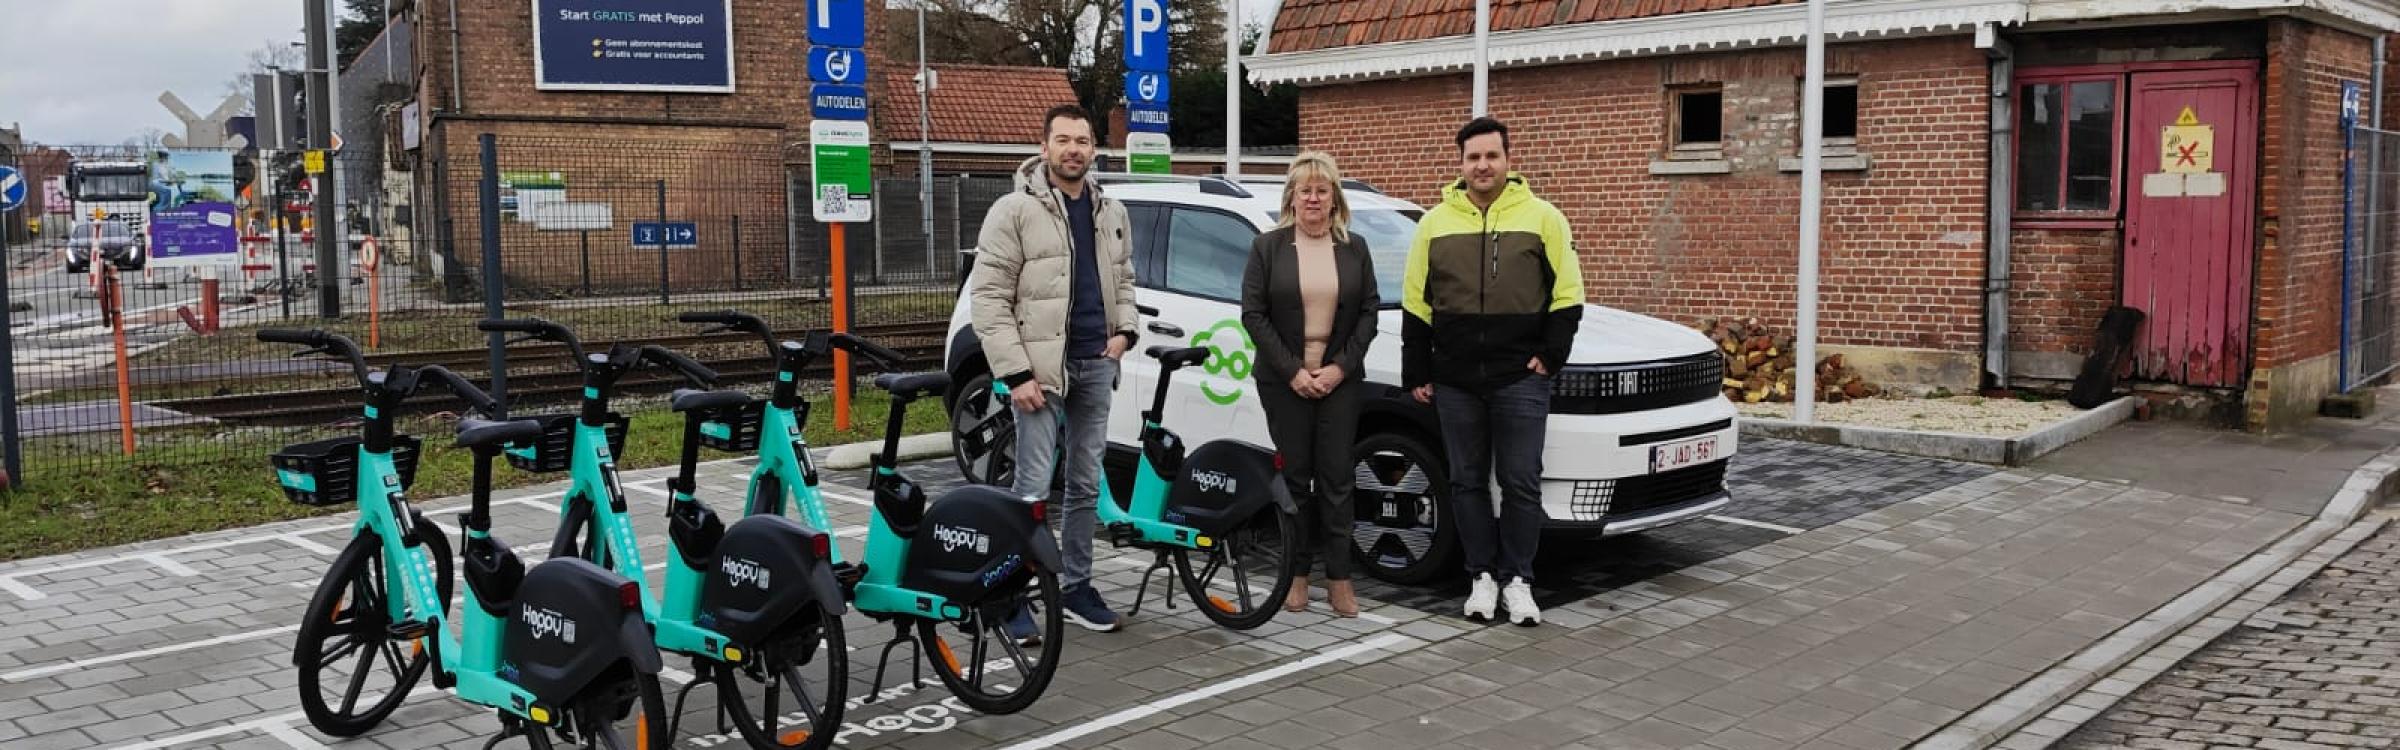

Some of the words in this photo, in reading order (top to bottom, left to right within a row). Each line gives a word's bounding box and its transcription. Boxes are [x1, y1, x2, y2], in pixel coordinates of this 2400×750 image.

[559, 9, 590, 21] Start
[592, 11, 635, 22] GRATIS
[638, 13, 662, 22] met
[665, 13, 704, 24] Peppol
[1132, 0, 1162, 57] P
[605, 39, 627, 48] Geen
[605, 50, 630, 58] Gratis
[653, 52, 705, 60] accountants
[816, 95, 866, 109] AUTODELEN
[1130, 110, 1169, 124] AUTODELEN
[1618, 371, 1639, 396] FIAT
